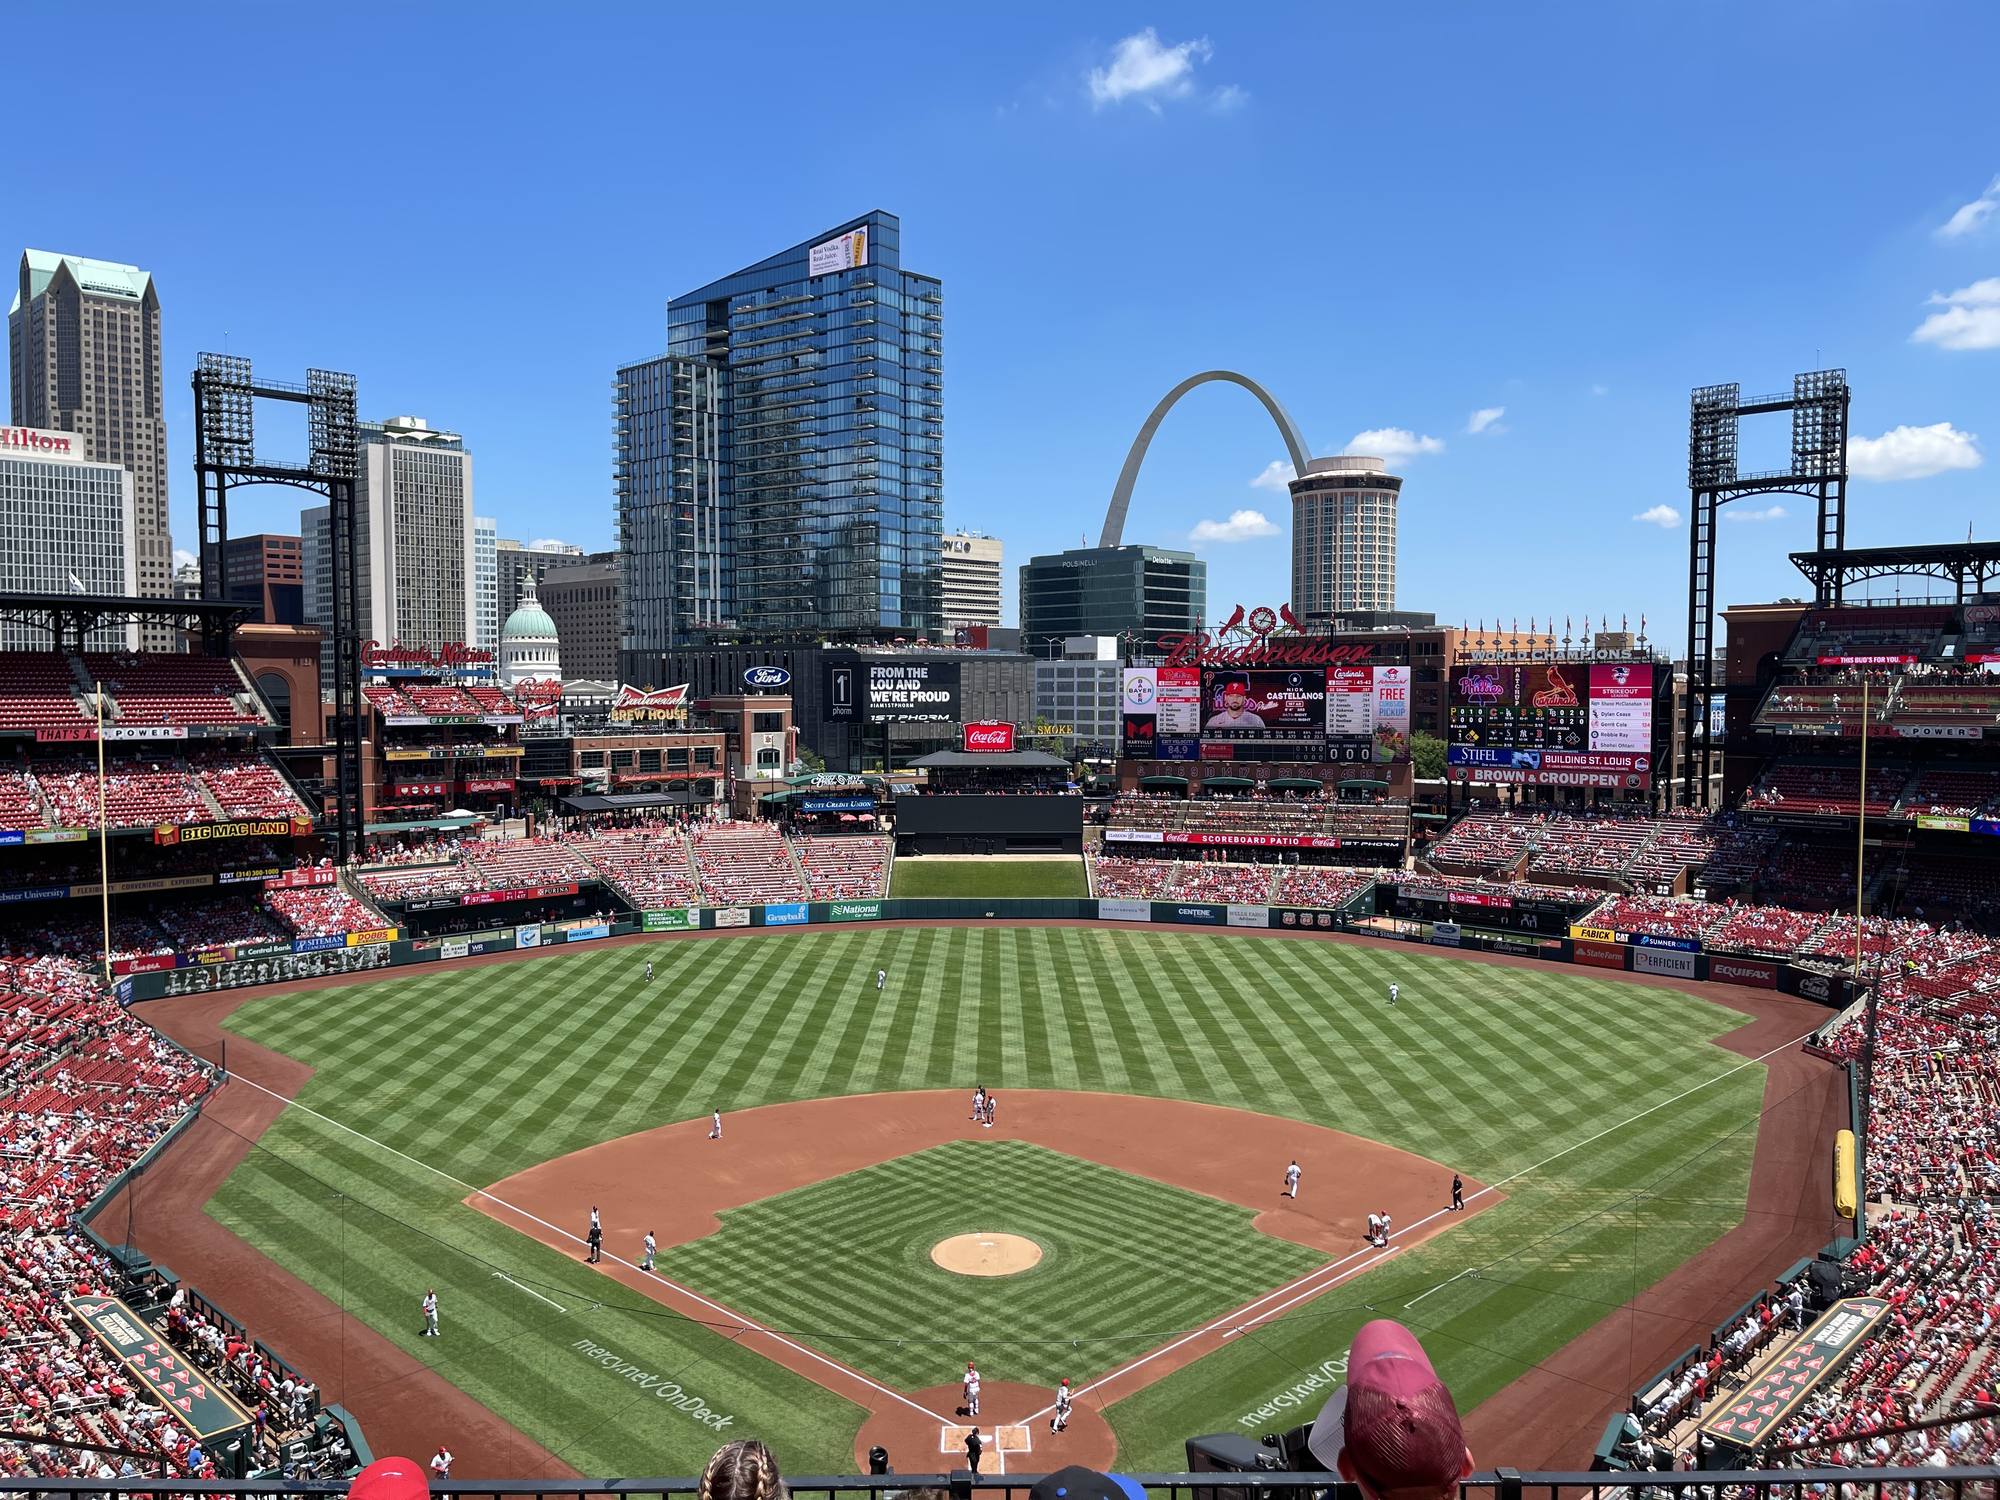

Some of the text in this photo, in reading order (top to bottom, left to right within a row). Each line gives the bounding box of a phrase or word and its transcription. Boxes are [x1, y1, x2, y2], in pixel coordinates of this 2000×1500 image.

[432, 642, 492, 667] Nation
[1157, 634, 1374, 668] Budweiser
[1471, 648, 1632, 661] WORLD CHAMPIONS
[754, 668, 782, 684] Ford
[870, 667, 928, 678] FROM THE
[1334, 668, 1364, 680] Cardinals
[870, 679, 920, 690] LOU AND
[1459, 677, 1504, 694] Phillies
[870, 691, 950, 702] WE'RE PROUD
[1380, 688, 1405, 700] FREE
[614, 692, 688, 708] Budweiser
[1533, 692, 1579, 708] Cardinals
[611, 708, 688, 721] BREW HOUSE
[832, 707, 852, 715] phorm
[1379, 708, 1406, 716] PICKUP
[40, 729, 92, 740] THAT'S A
[1038, 725, 1073, 734] SMOKE
[970, 731, 1007, 744] Coca-Cola
[1168, 746, 1188, 754] 84.9
[1330, 749, 1369, 760] 0 0 0
[1461, 747, 1498, 762] STIFEL
[1545, 754, 1632, 766] BUILDING ST. LOUIS
[1205, 768, 1215, 777] 10
[1222, 768, 1232, 777] 14
[1238, 768, 1249, 778] 17
[1256, 768, 1271, 778] 20
[1278, 768, 1293, 778] 23
[1299, 768, 1312, 778] 24
[1320, 769, 1334, 779] 42
[1341, 769, 1355, 779] 45
[1360, 770, 1375, 780] 85
[1474, 769, 1618, 786] BROWN & CROUPPEN
[182, 822, 289, 841] BIG MAC LAND
[1202, 836, 1264, 844] SCOREBOARD
[1312, 838, 1336, 847] Coca-Cola
[24, 888, 64, 898] University
[1412, 888, 1446, 897] Schnucks
[843, 904, 878, 914] National
[1178, 908, 1211, 916] CENTENE
[358, 931, 388, 940] DOBBS
[1380, 932, 1405, 940] STADIUM
[1581, 929, 1610, 940] FABICK
[1616, 932, 1629, 942] CAT
[308, 935, 344, 946] SITEMAN
[248, 944, 291, 955] Central Bank
[1714, 965, 1770, 980] EQUIFAX
[1825, 1314, 1864, 1346] CHAMPIONS
[572, 1339, 734, 1432] mercy.net/OnDeck
